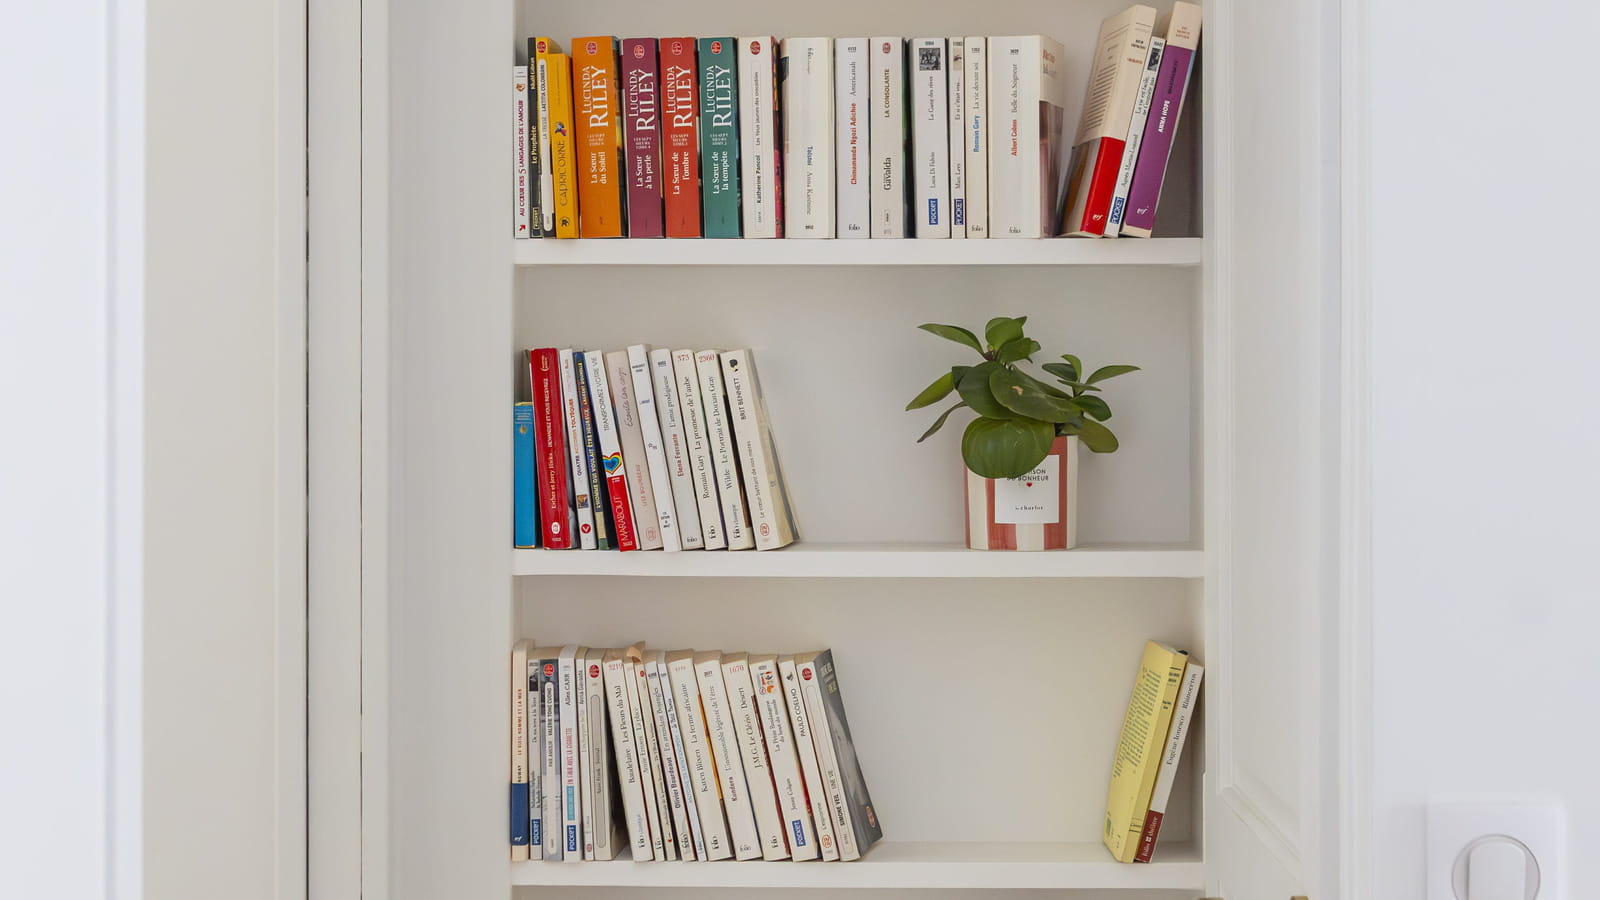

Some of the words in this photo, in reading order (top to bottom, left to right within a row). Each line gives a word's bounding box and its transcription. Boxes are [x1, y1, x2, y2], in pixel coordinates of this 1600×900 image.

[849, 62, 857, 96] Americanah
[1010, 64, 1019, 88] Seigneur
[582, 66, 592, 113] LUCINDA
[590, 65, 609, 127] RILEY
[629, 70, 639, 117] LUCINDA
[666, 66, 676, 113] LUCINDA
[674, 65, 692, 127] RILEY
[705, 65, 715, 113] LUCINDA
[713, 65, 732, 127] RILEY
[1011, 90, 1017, 98] du
[636, 69, 655, 131] RILEY
[884, 110, 890, 118] LA
[1157, 117, 1167, 132] ANNA
[1162, 100, 1170, 115] HOPE
[530, 126, 538, 155] Prophète
[598, 152, 606, 173] Soleil
[644, 155, 652, 174] perle
[672, 152, 679, 161] de
[682, 152, 690, 180] l'ombre
[712, 152, 719, 161] de
[720, 151, 730, 182] tempête
[558, 140, 568, 206] CAPRICORNE
[591, 175, 597, 184] La
[600, 175, 607, 184] du
[636, 178, 643, 187] La
[884, 157, 892, 190] Gavalda
[673, 186, 680, 194] La
[713, 185, 720, 194] La
[519, 208, 524, 216] AU
[955, 199, 963, 224] POCKET
[1110, 197, 1124, 223] POCKET
[594, 368, 603, 388] VOTRE
[683, 376, 693, 397] l'aube
[706, 376, 717, 392] Gray
[662, 375, 675, 408] prodigieuse
[733, 377, 744, 405] BENNETT
[598, 389, 610, 431] TRANSFORMEZ
[686, 398, 694, 407] de
[711, 393, 720, 416] Dorian
[738, 406, 746, 420] BRIT
[666, 408, 676, 428] L'amie
[688, 408, 702, 440] promesse
[714, 417, 721, 426] de
[586, 434, 594, 448] ÊTRE
[672, 434, 682, 458] Ferrante
[694, 441, 702, 450] La
[715, 428, 728, 453] Portrait
[588, 449, 596, 472] VOULAIT
[676, 460, 684, 477] Elena
[696, 454, 706, 470] Gary
[722, 454, 729, 464] Le
[699, 472, 710, 499] Romain
[723, 469, 733, 490] Wilde
[614, 495, 629, 541] MARABOUT
[614, 685, 623, 698] Mal
[680, 683, 693, 712] africaine
[737, 687, 748, 709] Désert
[790, 688, 802, 714] COELHO
[1181, 673, 1197, 709] Rhinocéros
[616, 699, 624, 709] du
[618, 711, 630, 730] Fleurs
[685, 714, 697, 733] ferme
[743, 714, 755, 734] Clézio
[796, 716, 806, 737] PAULO
[622, 731, 630, 743] Les
[663, 743, 670, 752] En
[690, 734, 698, 744] La
[748, 736, 755, 746] Le
[1165, 742, 1178, 765] Eugène
[1173, 716, 1186, 740] Ionesco
[624, 748, 636, 783] Baudelaire
[694, 749, 704, 771] Blixen
[750, 748, 764, 769] J.M.G.
[666, 757, 678, 788] Bourdeaut
[698, 772, 709, 793] Karen
[727, 776, 738, 802] Kundera
[830, 779, 838, 789] UNE
[671, 789, 681, 809] Olivier
[833, 794, 841, 804] VEIL
[836, 806, 845, 826] SIMONE
[568, 826, 576, 850] POCKET
[793, 821, 805, 846] POCKET
